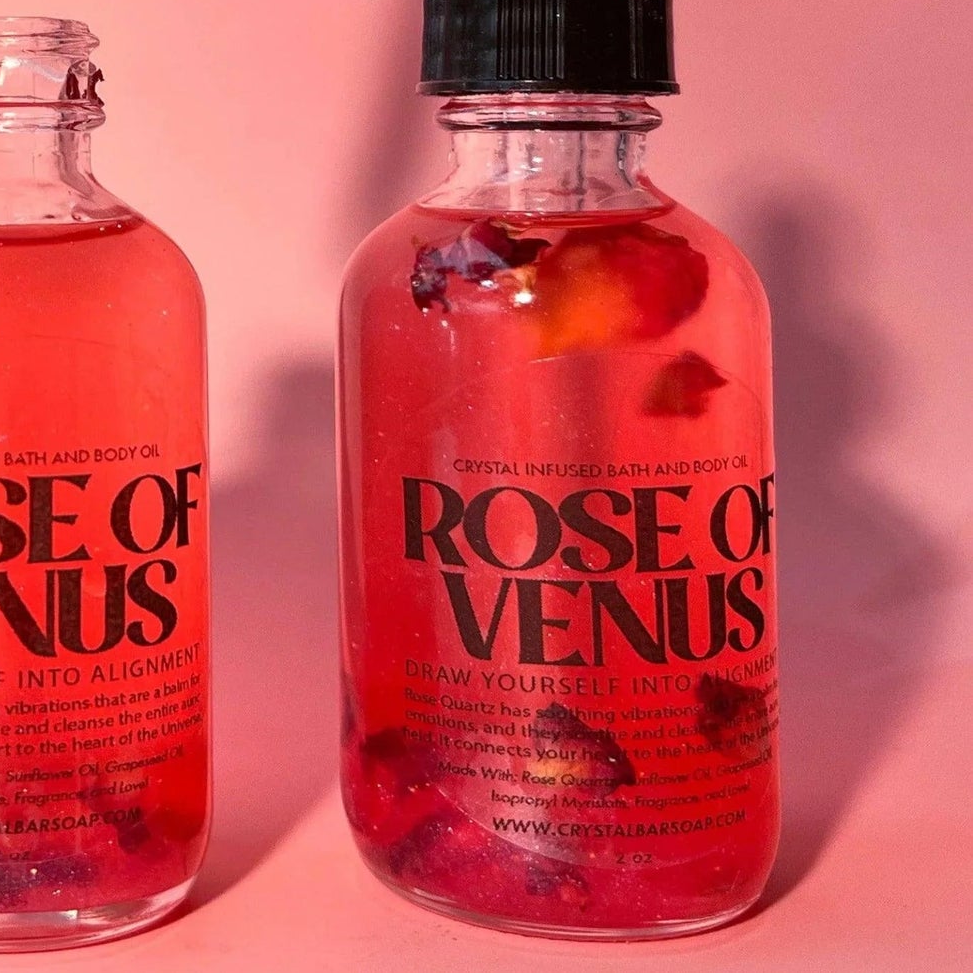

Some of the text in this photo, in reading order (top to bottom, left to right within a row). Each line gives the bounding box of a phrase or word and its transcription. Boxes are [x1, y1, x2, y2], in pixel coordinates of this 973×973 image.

[4, 452, 46, 465] BATH
[52, 449, 90, 465] AND
[94, 446, 137, 462] BODY
[140, 444, 160, 458] OIL
[453, 455, 748, 477] CRYSTAL INFUSED BATH AND BODY OIL
[110, 462, 202, 554] OF
[403, 473, 774, 573] ROSE OF
[439, 567, 765, 667] VENUS
[18, 667, 80, 689] INTO
[90, 642, 201, 683] ALIGNMENT
[405, 659, 471, 687] DRAW
[481, 672, 620, 696] YOURSELF
[632, 674, 691, 694] INTO
[5, 698, 91, 715] vibrations
[94, 692, 126, 708] that
[128, 689, 150, 704] are
[153, 689, 161, 699] a
[163, 681, 189, 696] balm
[189, 673, 201, 687] for
[405, 688, 437, 706] Rose
[440, 695, 496, 715] Quartz
[500, 702, 531, 718] has
[621, 705, 700, 721] vibrations
[14, 719, 50, 735] and
[54, 717, 115, 733] cleanse
[119, 710, 143, 725] the
[145, 702, 180, 721] entire
[405, 710, 479, 733] emotions,
[483, 723, 515, 737] and
[521, 723, 561, 743] they
[632, 727, 663, 741] and
[15, 741, 35, 756] to
[39, 739, 68, 754] the
[72, 735, 115, 751] heart
[118, 731, 134, 746] of
[137, 727, 158, 742] the
[439, 734, 451, 747] It
[453, 737, 531, 758] connects
[536, 746, 577, 762] your
[634, 747, 650, 759] to
[656, 745, 682, 758] the
[6, 767, 74, 783] Sunflower
[105, 751, 169, 775] Grapeseed
[437, 760, 556, 786] Made With: Rose
[91, 781, 116, 796] and
[491, 789, 557, 809] Isopropyl
[492, 809, 746, 838] WWW.CRYSTALBARSOAP.COM
[616, 853, 625, 864] 2
